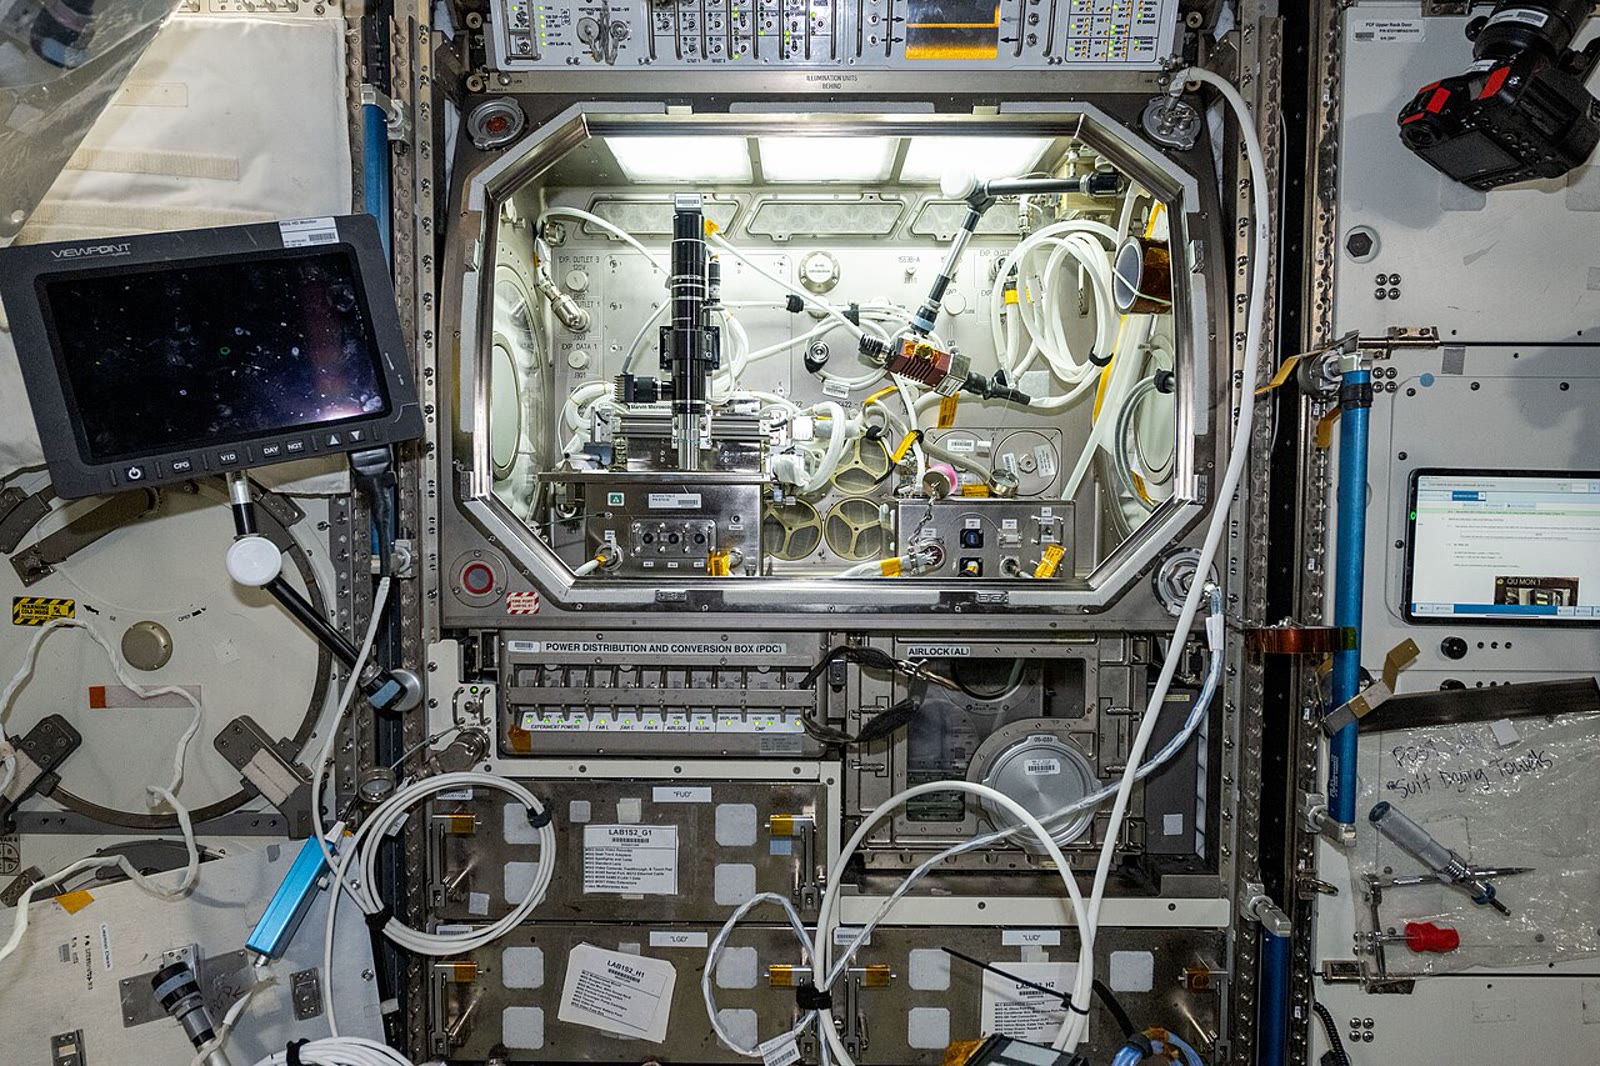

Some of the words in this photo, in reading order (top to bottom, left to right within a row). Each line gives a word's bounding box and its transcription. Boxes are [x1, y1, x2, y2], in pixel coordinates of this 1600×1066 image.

[51, 243, 130, 258] VIEWPOINT
[264, 446, 278, 455] DAY
[288, 442, 303, 450] NGT
[220, 452, 236, 462] VID
[173, 461, 190, 470] CFG
[582, 644, 646, 652] DISTRIBUTION
